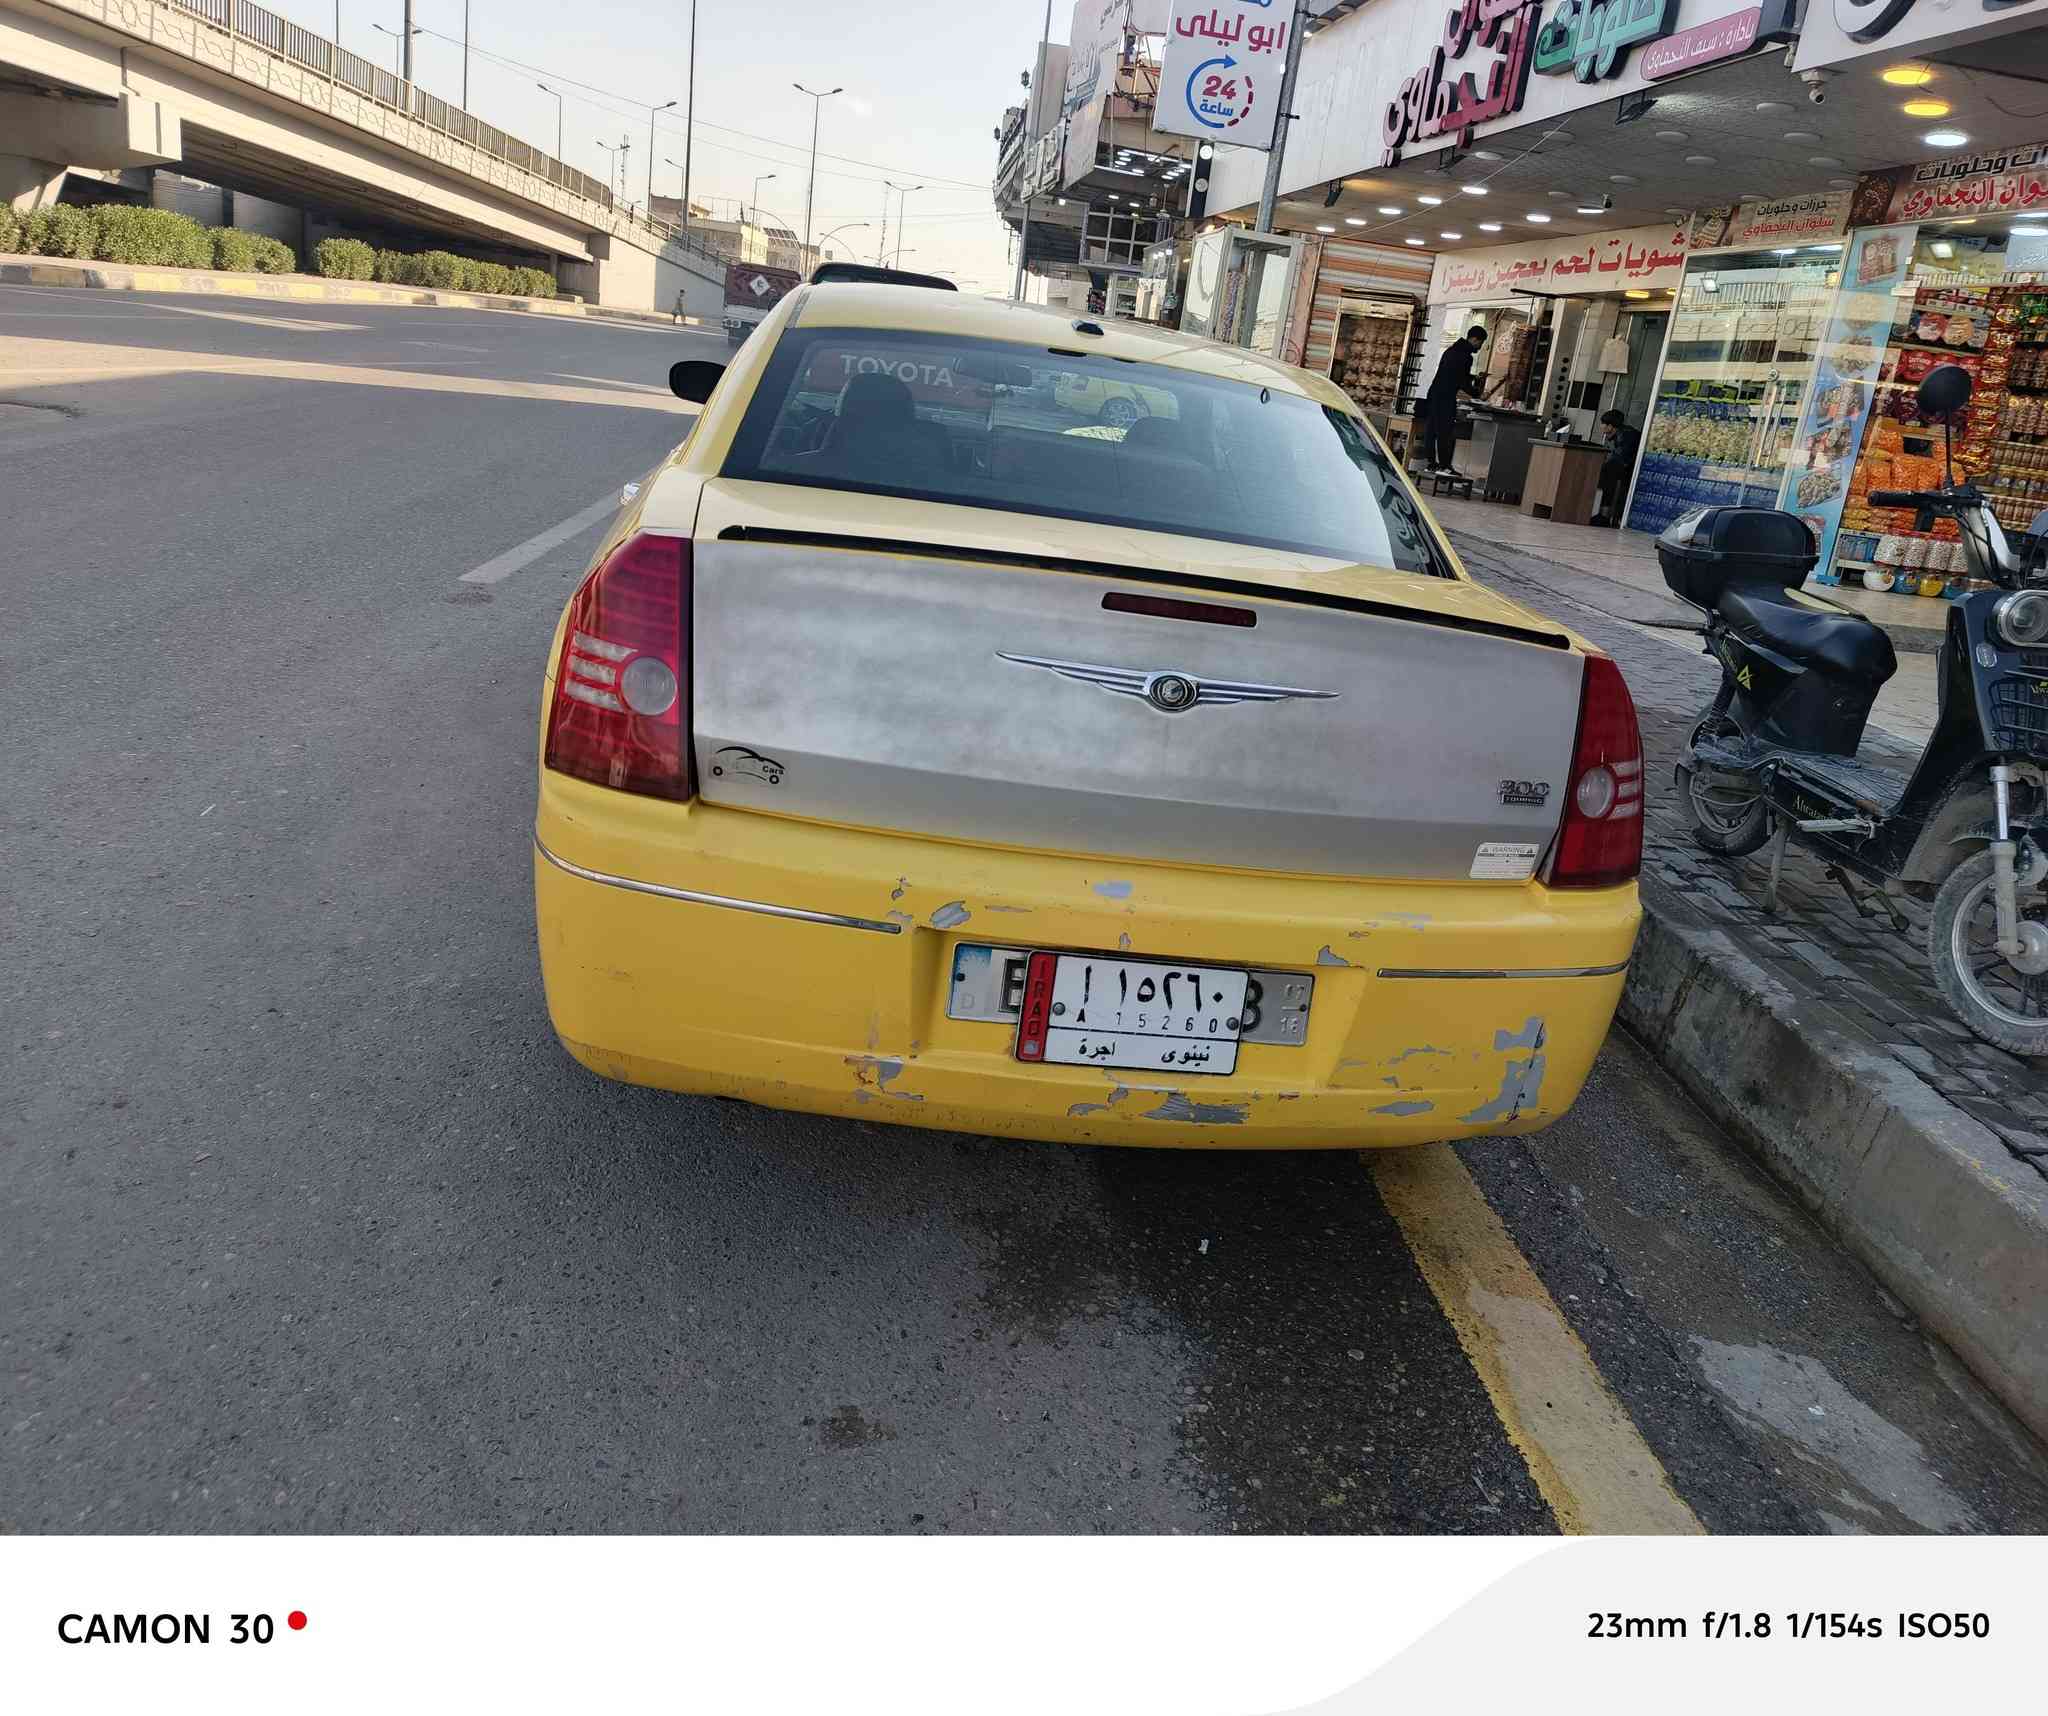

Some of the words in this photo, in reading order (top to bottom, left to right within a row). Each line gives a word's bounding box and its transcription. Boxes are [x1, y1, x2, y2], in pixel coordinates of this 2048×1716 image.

[1175, 8, 1245, 47] ليلى
[1247, 22, 1286, 54] ابو
[1202, 75, 1237, 100] 24
[1200, 99, 1234, 117] ساعة
[1902, 178, 1995, 217] النجماوي
[1551, 245, 1595, 281] لحم
[1599, 231, 1685, 277] شويات
[840, 354, 953, 388] TOYOTA
[1078, 1038, 1116, 1061] اجرة
[1160, 1044, 1211, 1067] نينوى
